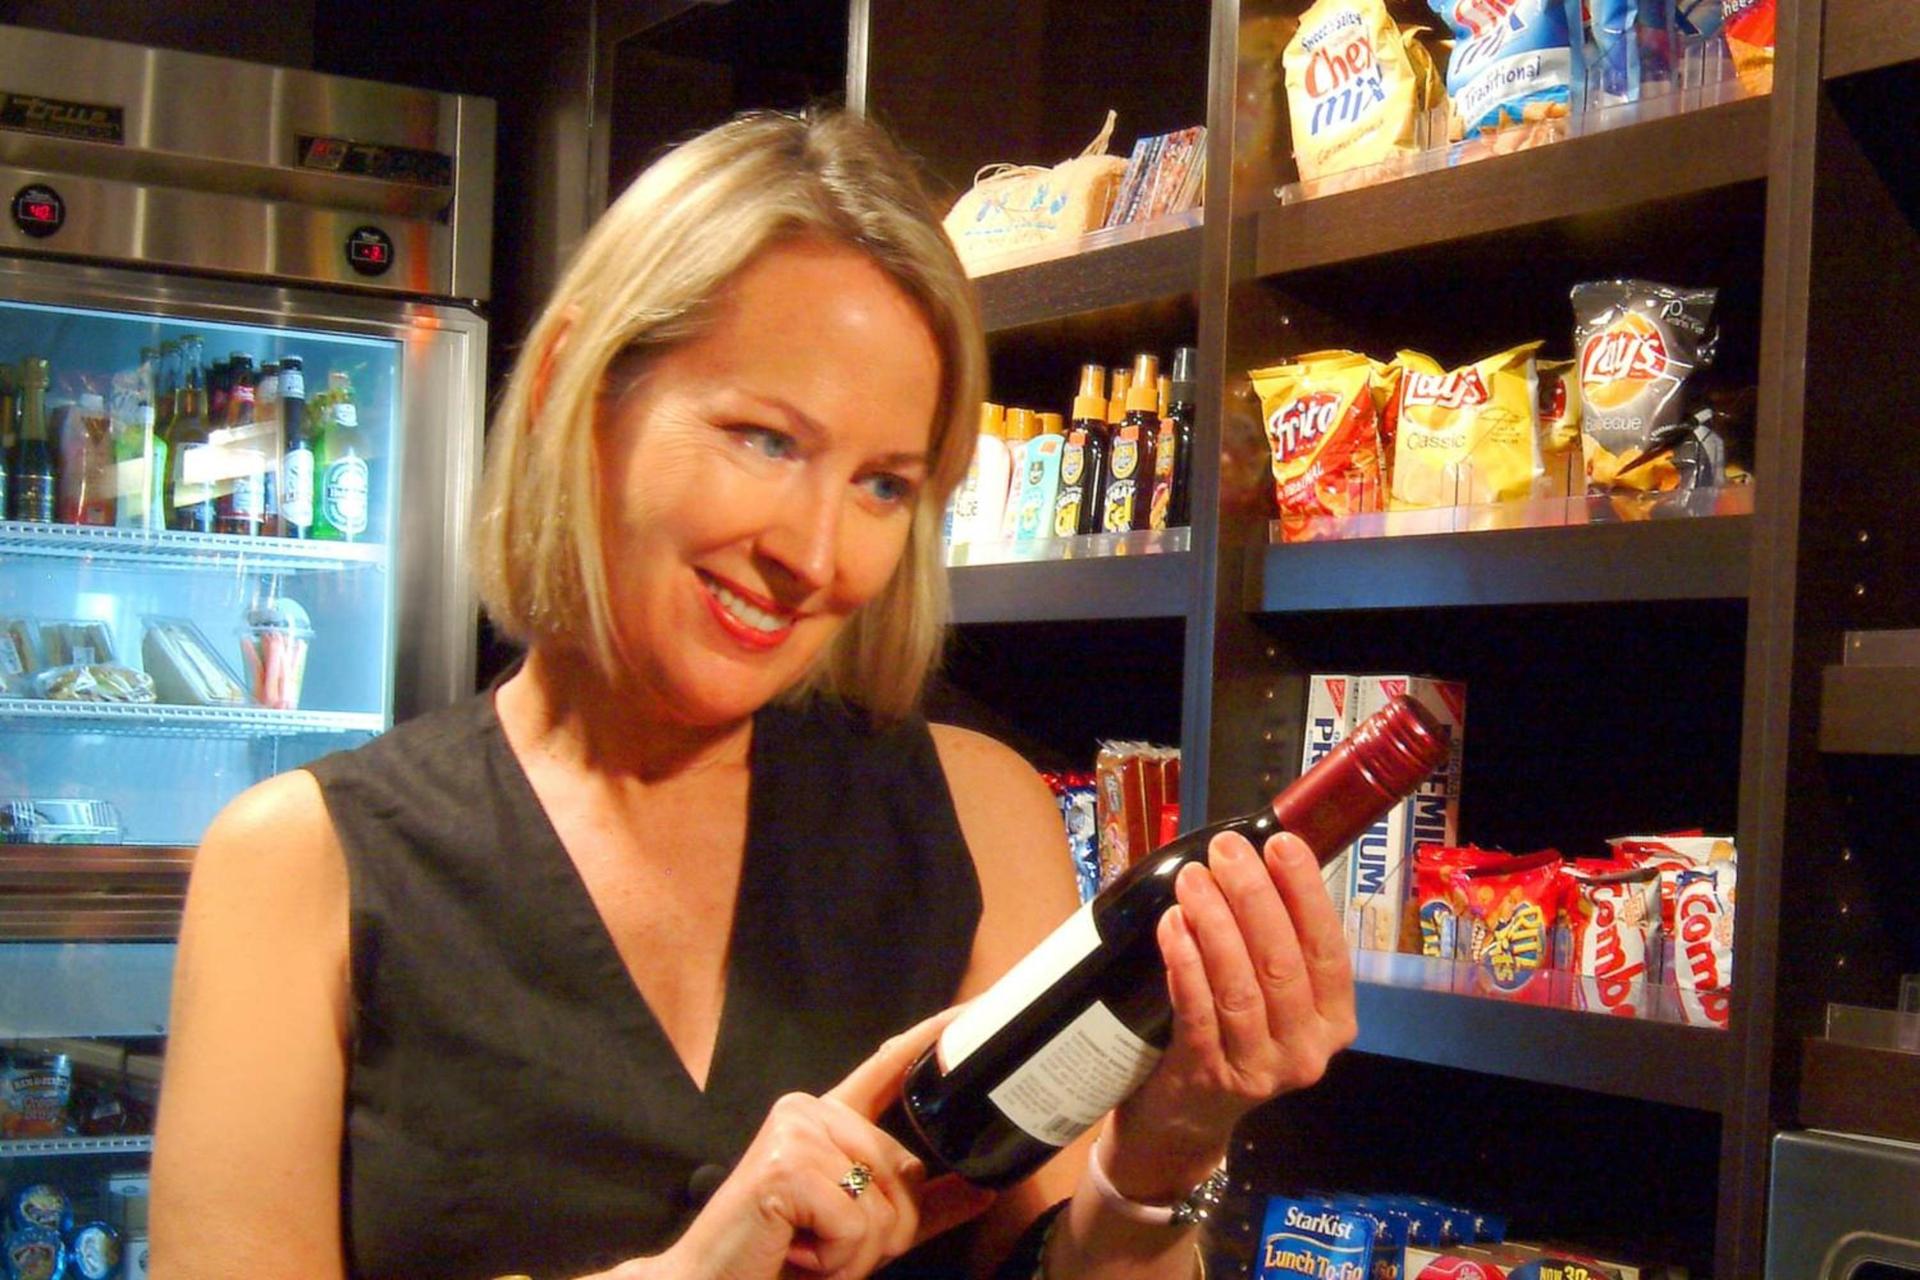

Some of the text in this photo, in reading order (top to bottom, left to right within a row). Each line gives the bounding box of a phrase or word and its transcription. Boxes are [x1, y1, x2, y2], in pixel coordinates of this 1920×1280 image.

[1305, 36, 1374, 99] Chex
[1311, 64, 1385, 136] mix
[1270, 390, 1344, 463] Frito
[1407, 431, 1466, 451] Classic
[1589, 882, 1645, 1017] Comb
[1680, 893, 1731, 1028] Comb
[1284, 1206, 1354, 1239] StarKist
[1264, 1244, 1316, 1275] Lunch
[1316, 1255, 1364, 1280] To-Go
